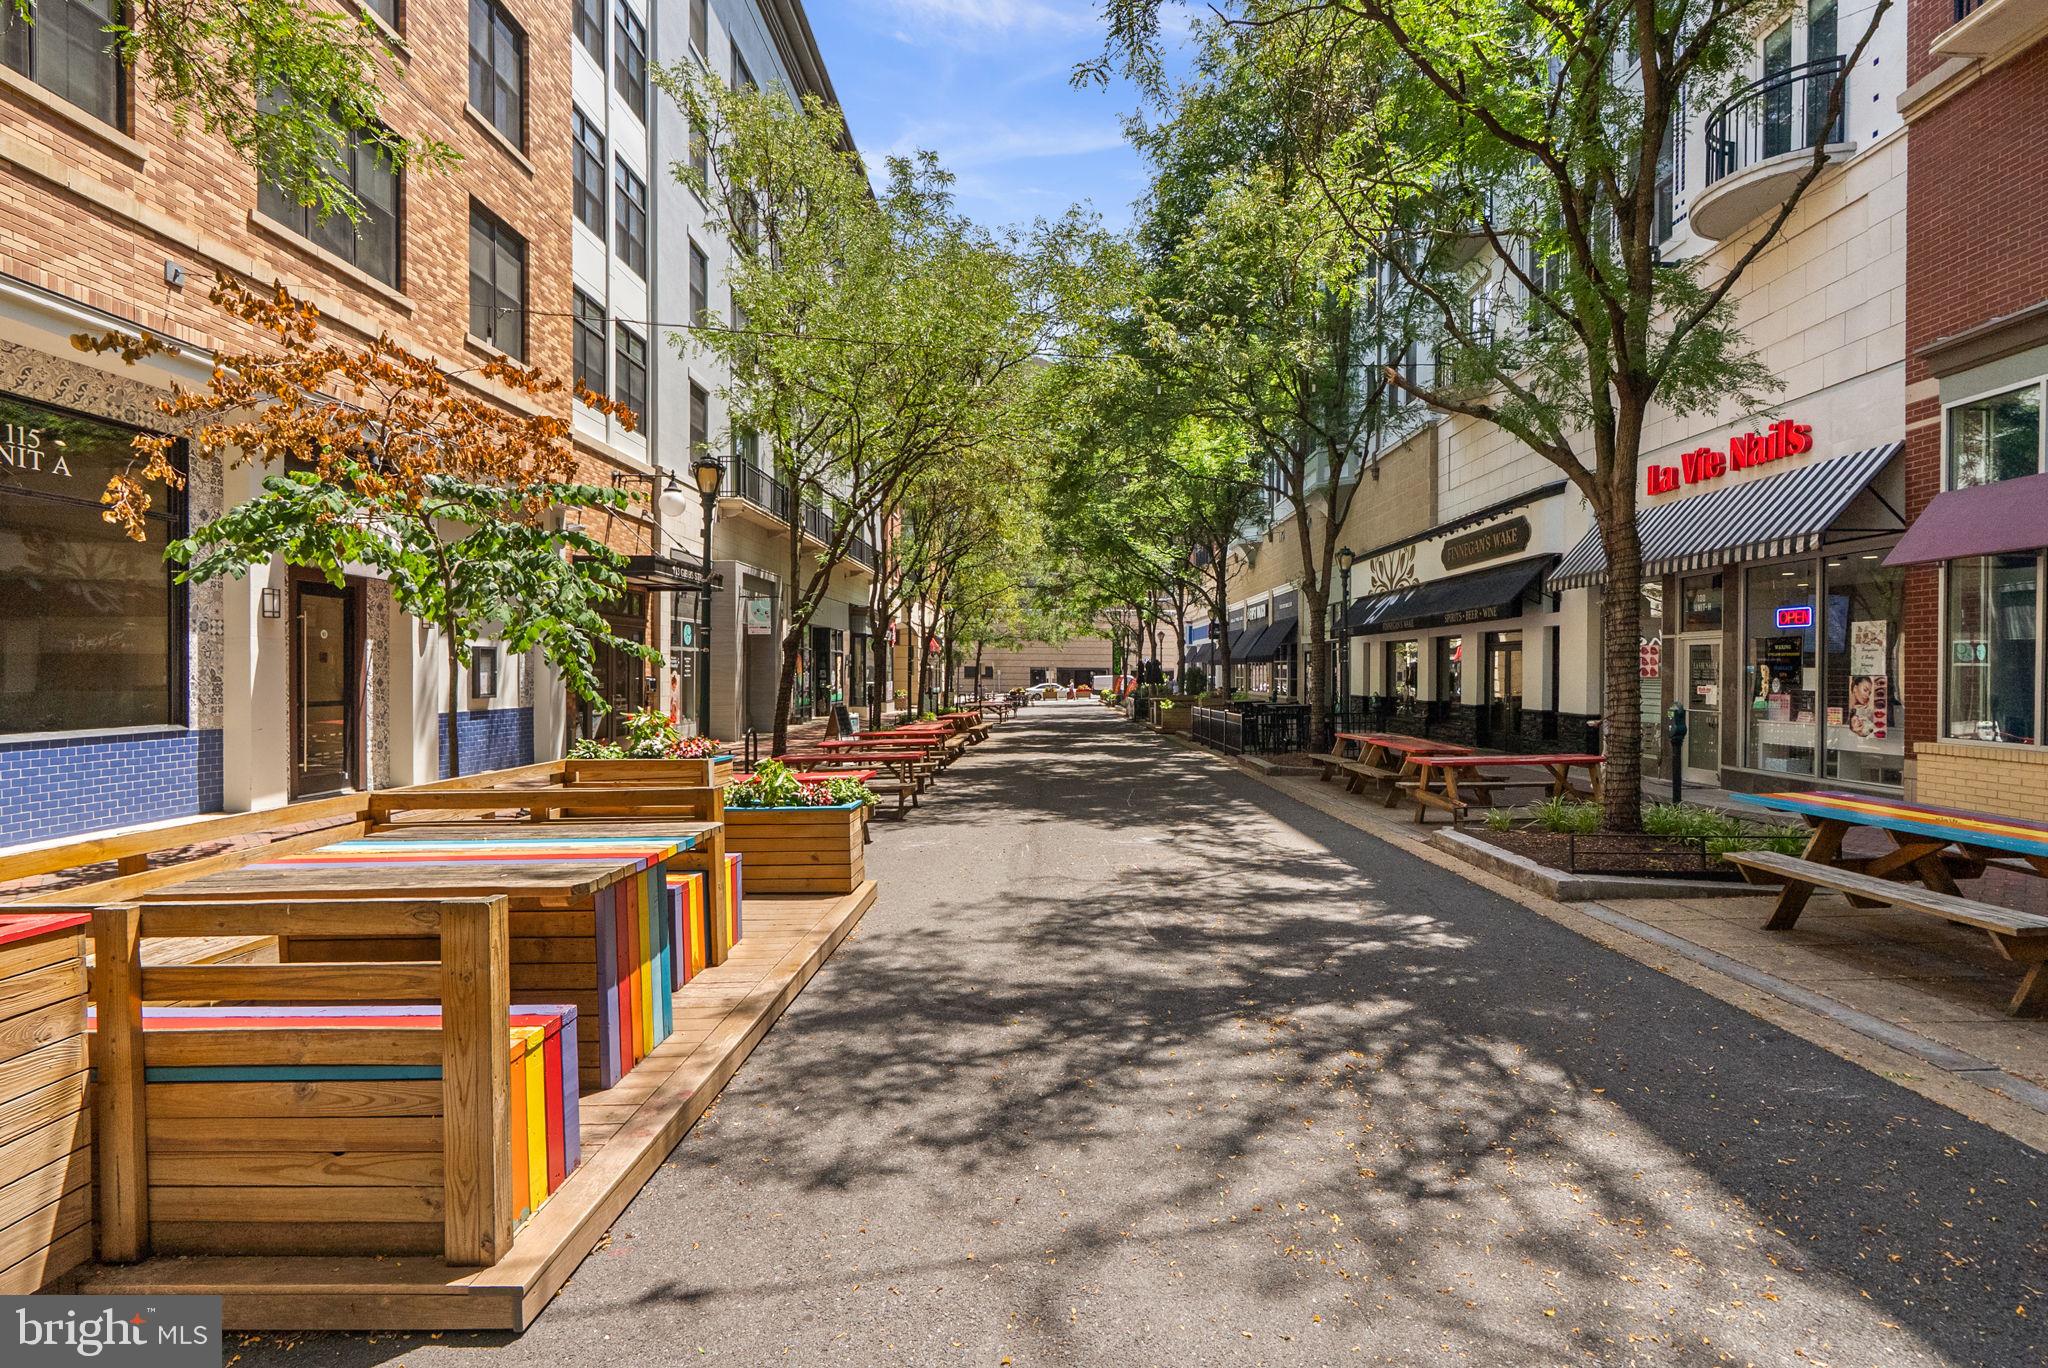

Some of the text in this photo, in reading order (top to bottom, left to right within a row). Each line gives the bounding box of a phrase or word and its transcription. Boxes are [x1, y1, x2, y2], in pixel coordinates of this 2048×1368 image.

[6, 424, 40, 449] 115
[0, 444, 72, 477] NIT A
[1648, 419, 1813, 496] La Vie Nails
[1447, 527, 1518, 561] FINNEGAN'S WAKE
[1465, 609, 1478, 620] BEER
[1482, 607, 1497, 617] WINE
[1779, 609, 1810, 624] OPEN
